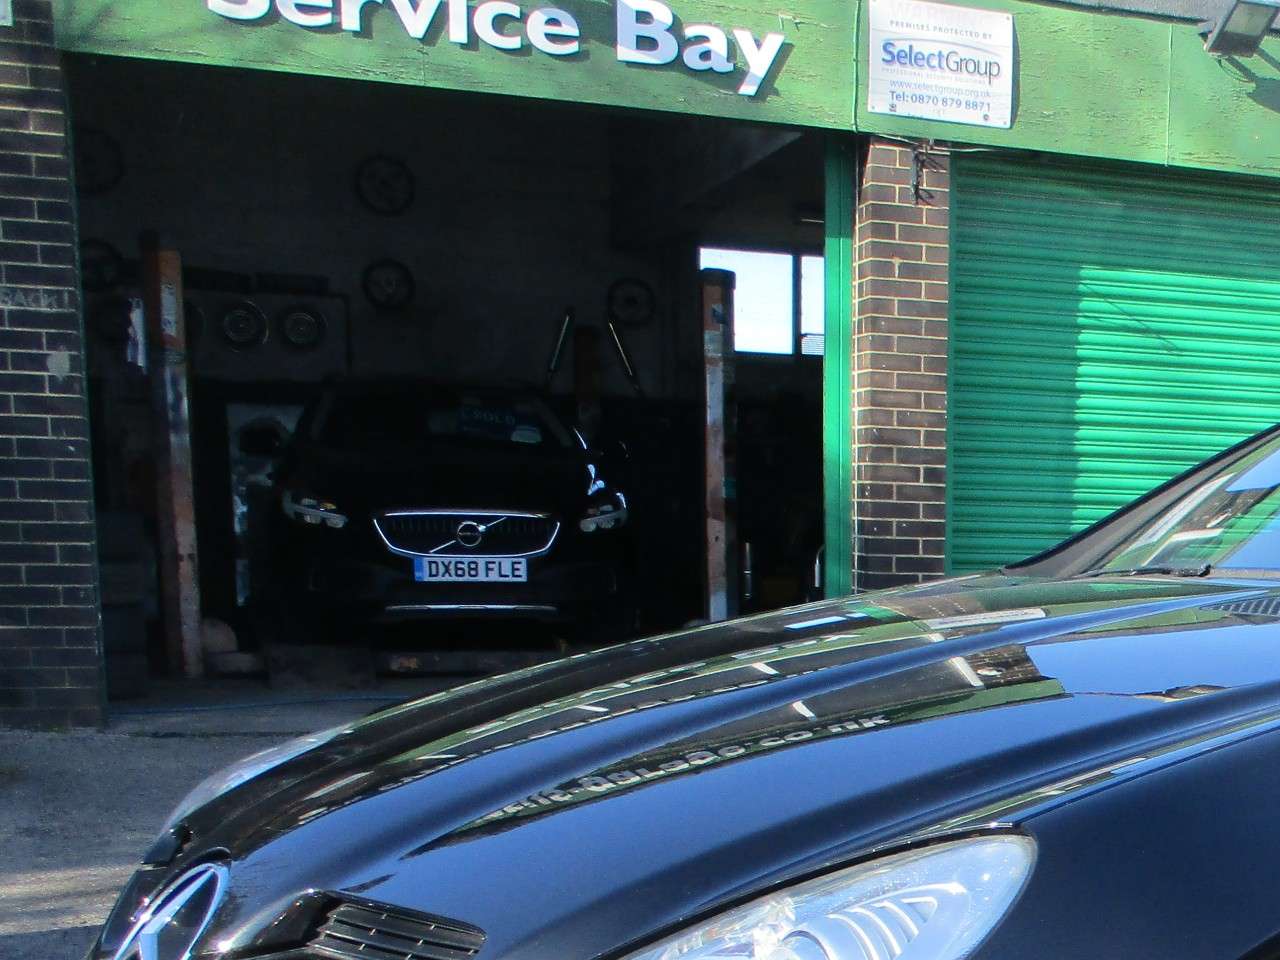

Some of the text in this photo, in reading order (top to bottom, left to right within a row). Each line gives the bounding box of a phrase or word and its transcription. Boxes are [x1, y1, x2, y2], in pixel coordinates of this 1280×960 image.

[890, 20, 930, 32] PREMISES
[933, 26, 980, 38] PROTECTED
[616, 0, 785, 96] Bay
[882, 42, 1001, 85] SelectGroup
[889, 91, 992, 112] Tel: 0870 879 8871
[428, 560, 523, 578] DX68 FLE
